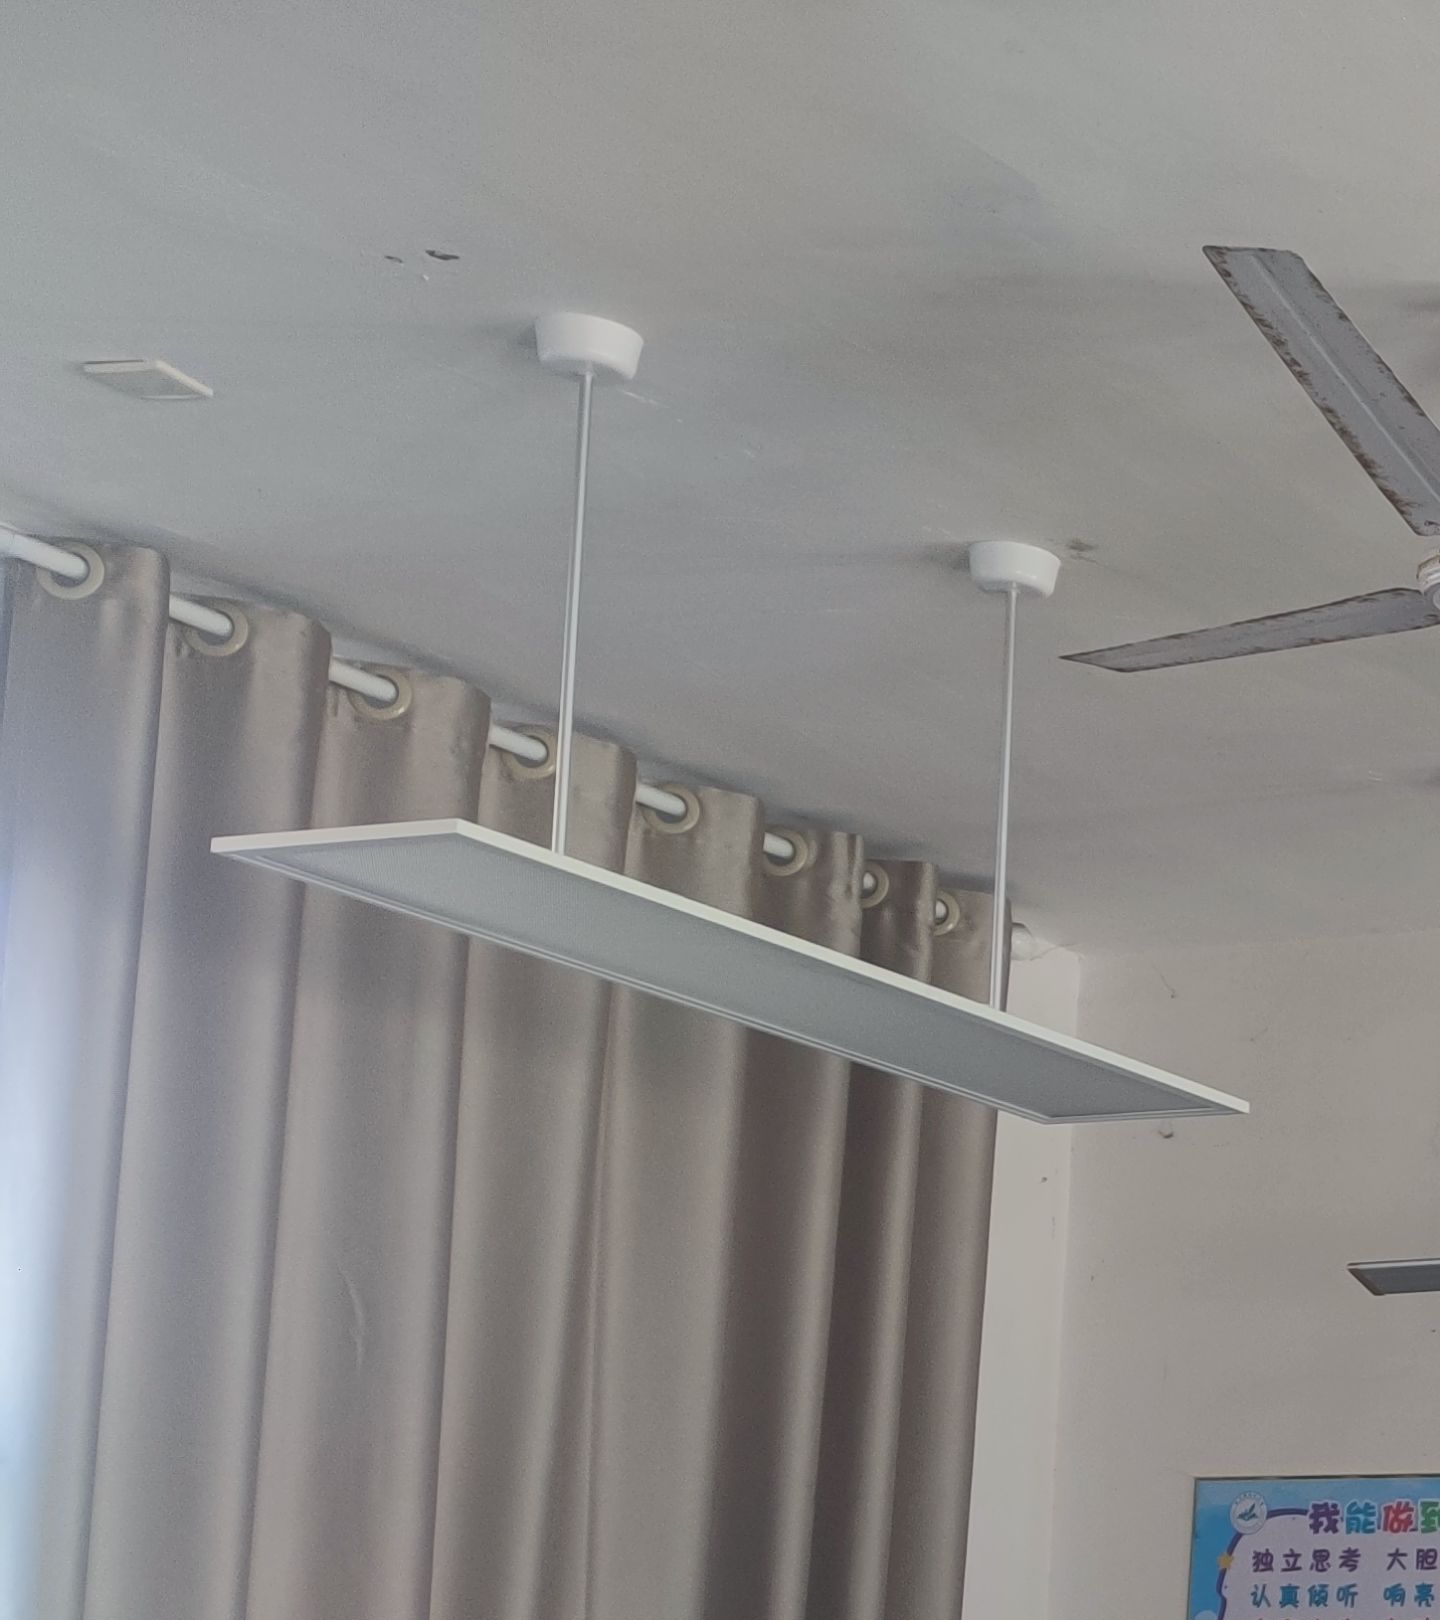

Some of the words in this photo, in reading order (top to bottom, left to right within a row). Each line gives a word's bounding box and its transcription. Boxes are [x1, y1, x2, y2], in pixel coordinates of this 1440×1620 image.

[1252, 1549, 1361, 1573] 独立思考
[1250, 1584, 1359, 1608] 认真倾听
